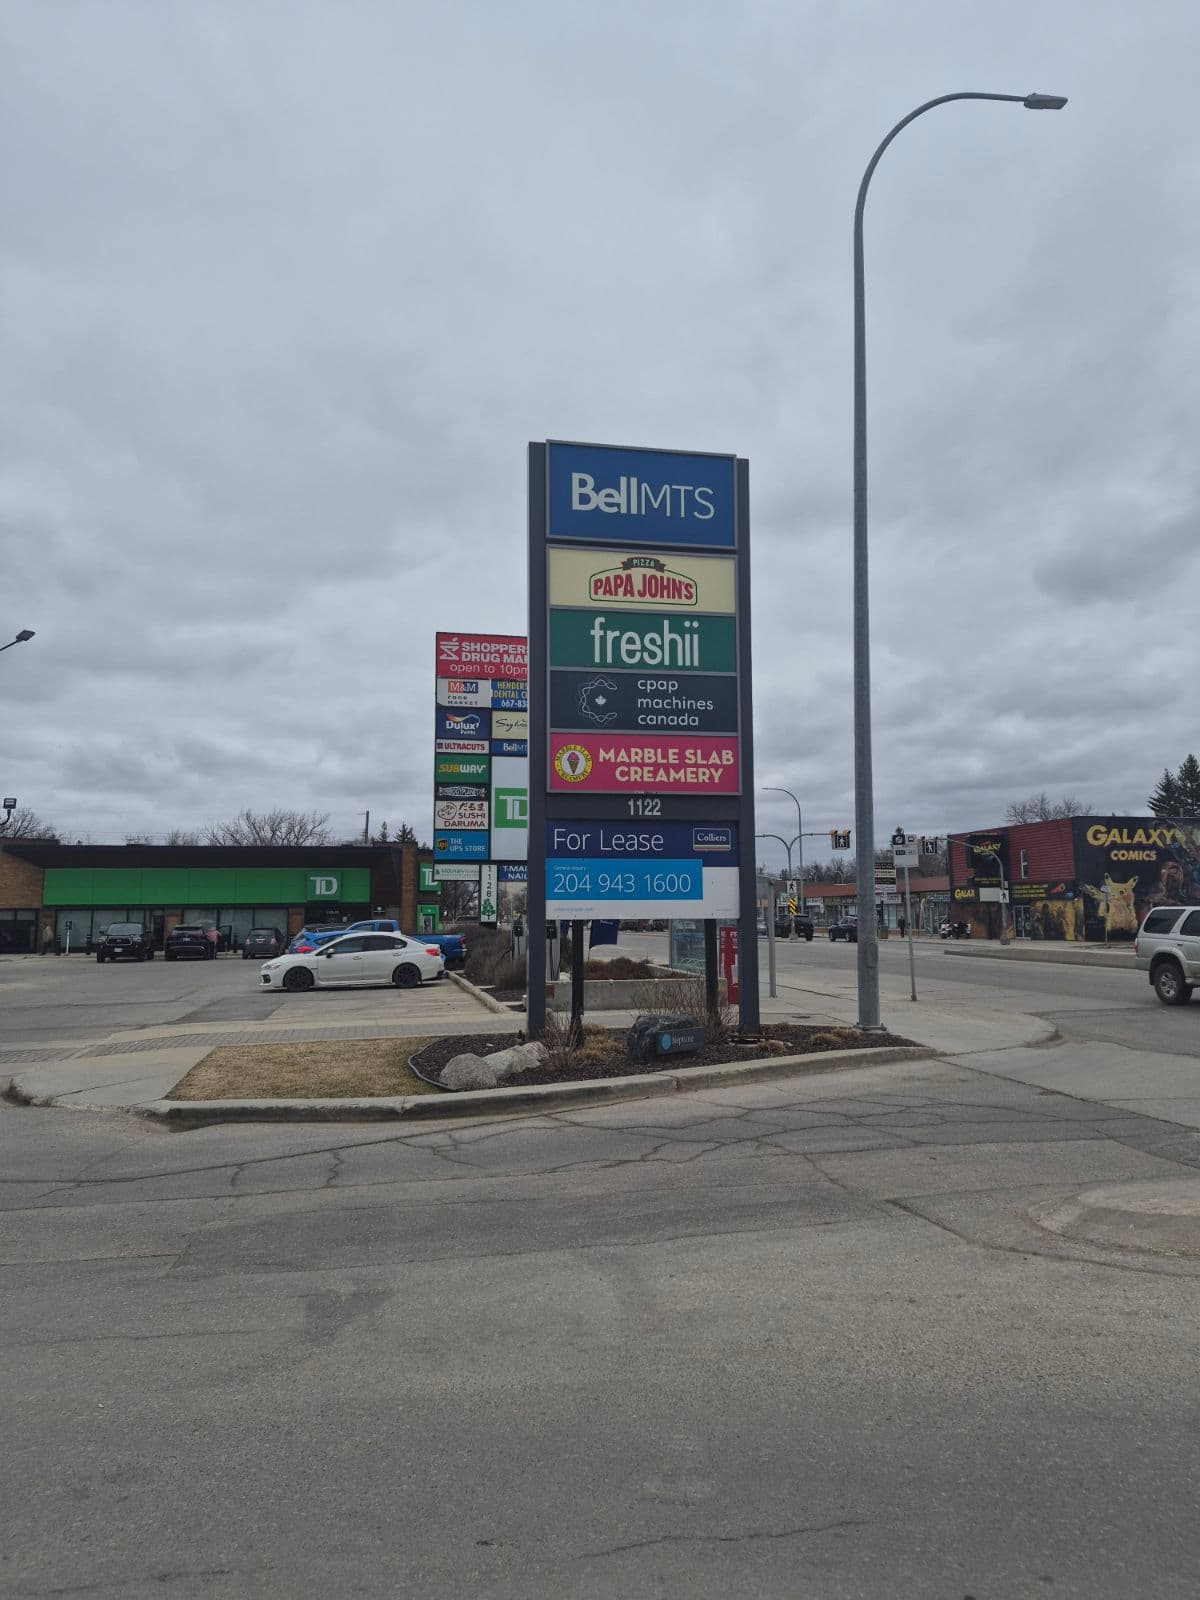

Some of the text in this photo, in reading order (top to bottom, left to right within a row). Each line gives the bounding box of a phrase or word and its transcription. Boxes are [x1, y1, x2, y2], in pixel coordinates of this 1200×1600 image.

[571, 472, 715, 520] BellMTS
[632, 559, 655, 567] PIZZA
[593, 574, 694, 600] PAPA JOHN'S
[462, 642, 527, 655] SHOPPER
[590, 617, 699, 667] freshii
[462, 652, 500, 663] DRUG
[450, 664, 480, 673] open
[484, 665, 495, 673] to
[450, 682, 476, 692] M&M
[637, 679, 679, 692] cpap
[637, 697, 714, 710] machines
[446, 721, 475, 730] Dulux
[637, 713, 699, 726] canada
[445, 743, 485, 751] ULTRACUTS
[599, 748, 734, 765] MARBLE SLAB
[439, 765, 486, 774] SUBWAY
[615, 766, 724, 783] CREAMERY
[627, 798, 661, 816] 1122
[444, 820, 485, 828] DARUMA
[553, 828, 664, 851] For Lease
[697, 833, 727, 842] Colliers
[1086, 824, 1173, 848] GALAXY
[1110, 850, 1157, 861] COMICS
[310, 876, 338, 895] TD
[553, 873, 692, 893] 204 943 1600
